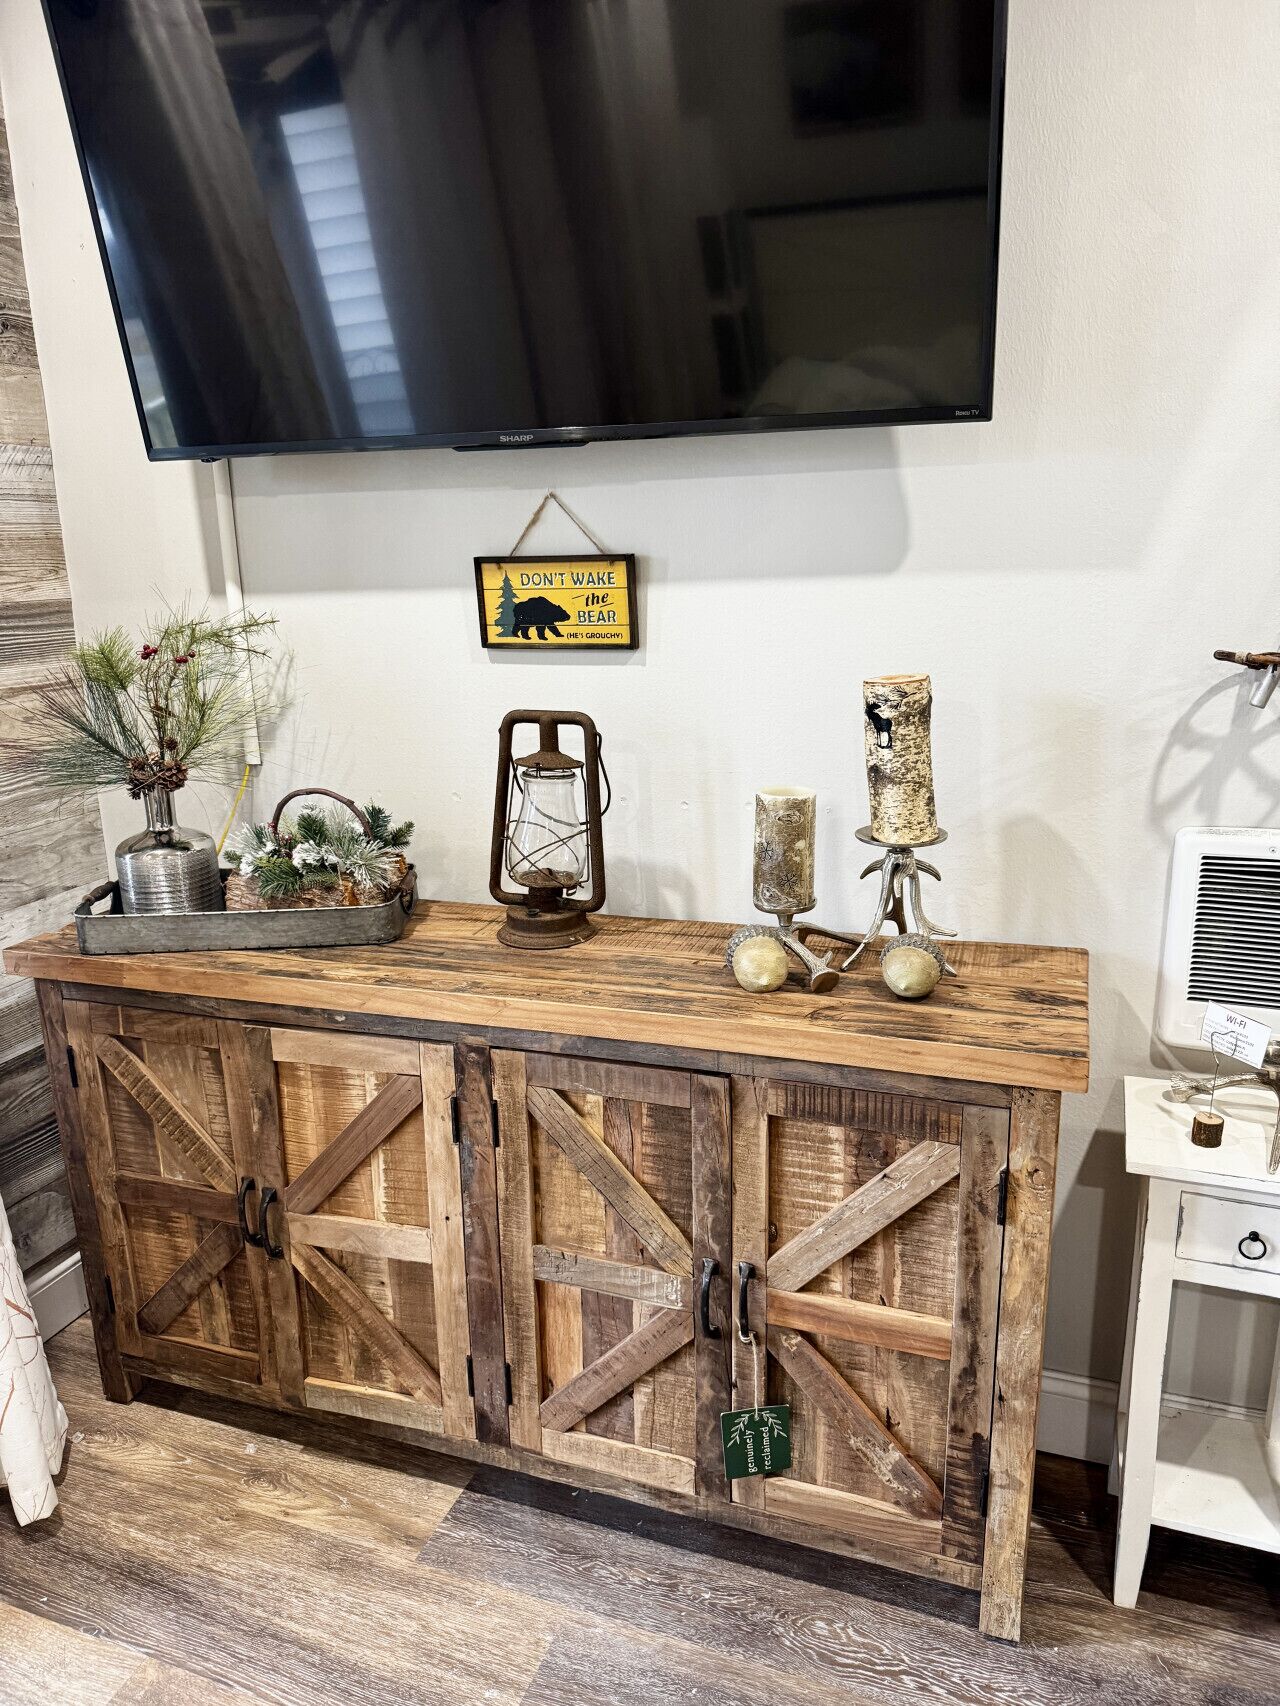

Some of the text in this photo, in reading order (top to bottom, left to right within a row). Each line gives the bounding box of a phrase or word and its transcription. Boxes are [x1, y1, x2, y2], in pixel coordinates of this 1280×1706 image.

[499, 434, 534, 442] SHARP
[520, 571, 616, 587] DON'T WAKE
[585, 592, 609, 607] the
[577, 610, 617, 624] BEAR
[566, 632, 624, 640] (HE'S GROUCHY)
[1226, 1013, 1247, 1029] WI-FI
[743, 1430, 758, 1473] genuinely
[759, 1426, 772, 1470] reclaimed
